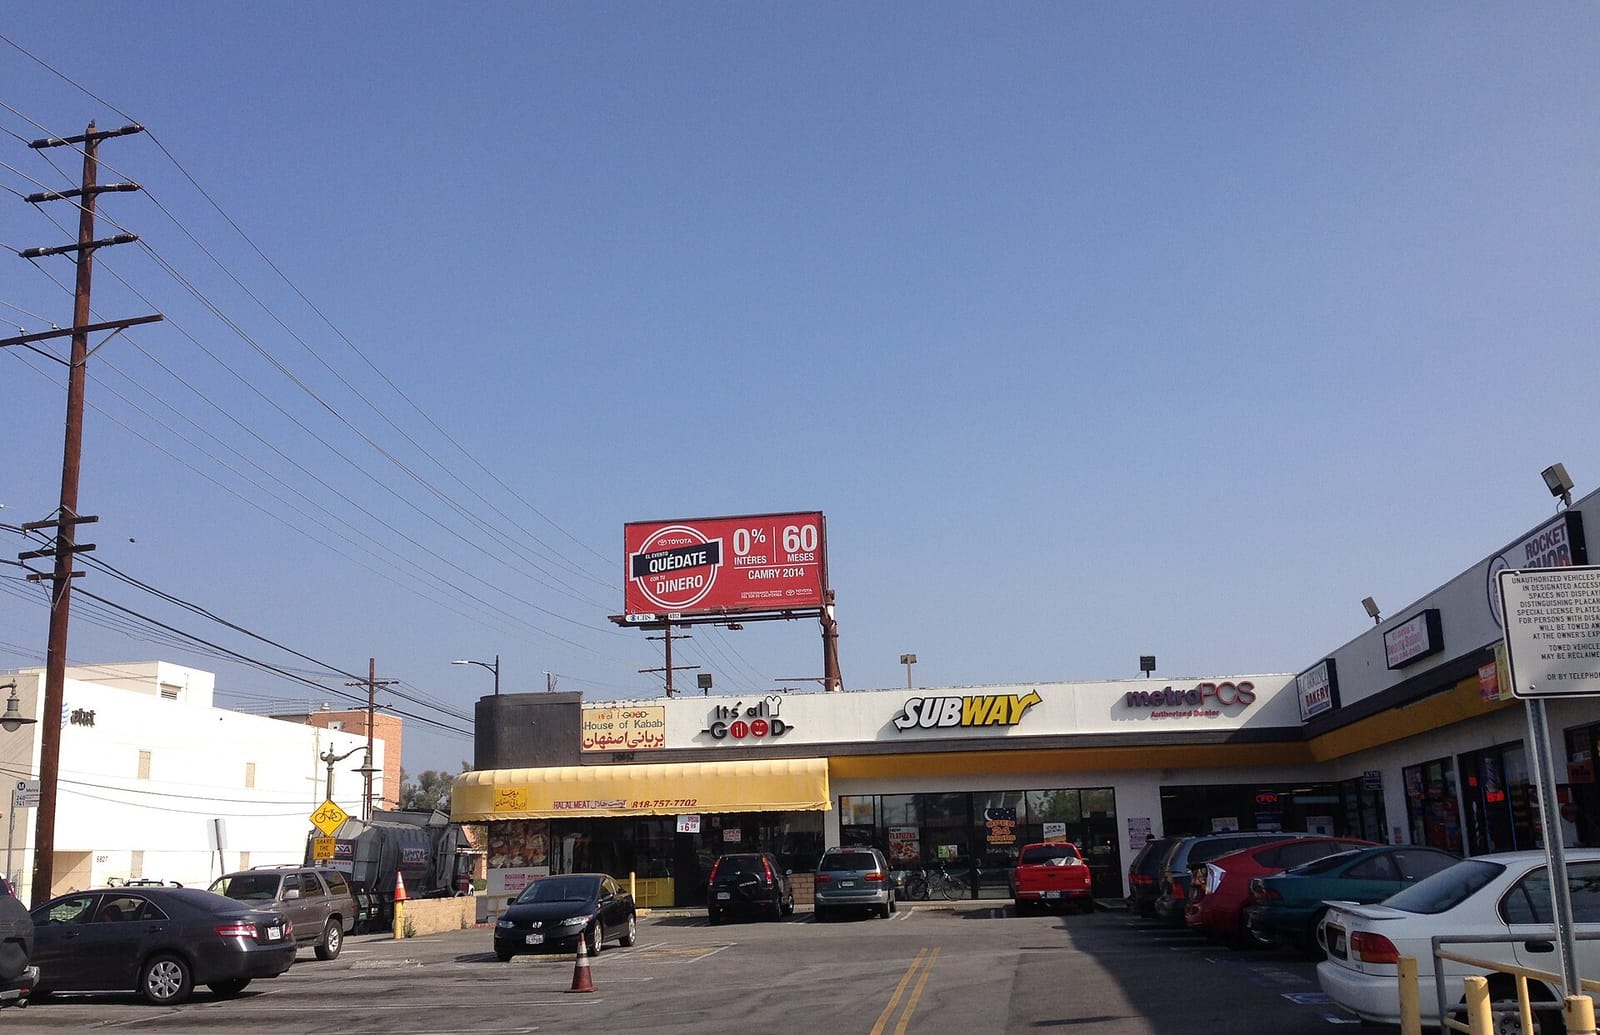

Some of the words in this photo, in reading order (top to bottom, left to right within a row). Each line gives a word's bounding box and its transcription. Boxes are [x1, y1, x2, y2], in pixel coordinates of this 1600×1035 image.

[733, 528, 766, 556] 0%
[782, 524, 818, 552] 60
[1524, 523, 1566, 560] ROCKET
[649, 552, 707, 573] QUÉDATE
[787, 552, 814, 562] MESES
[748, 568, 780, 580] CAMRY
[782, 568, 804, 578] 2014
[1512, 575, 1561, 584] UNAUTHORIZED
[1563, 574, 1594, 582] VEHICLES
[656, 575, 703, 594] DINERO
[1520, 600, 1573, 608] DISTINGUISHING
[1126, 681, 1256, 707] metroPCS
[1305, 685, 1329, 706] BAKERY
[893, 690, 1042, 732] SUBWAY
[1151, 710, 1192, 718] Authorized
[584, 721, 614, 730] House
[619, 720, 628, 728] of
[634, 719, 662, 728] Kabab
[632, 799, 697, 808] 818-757-7702
